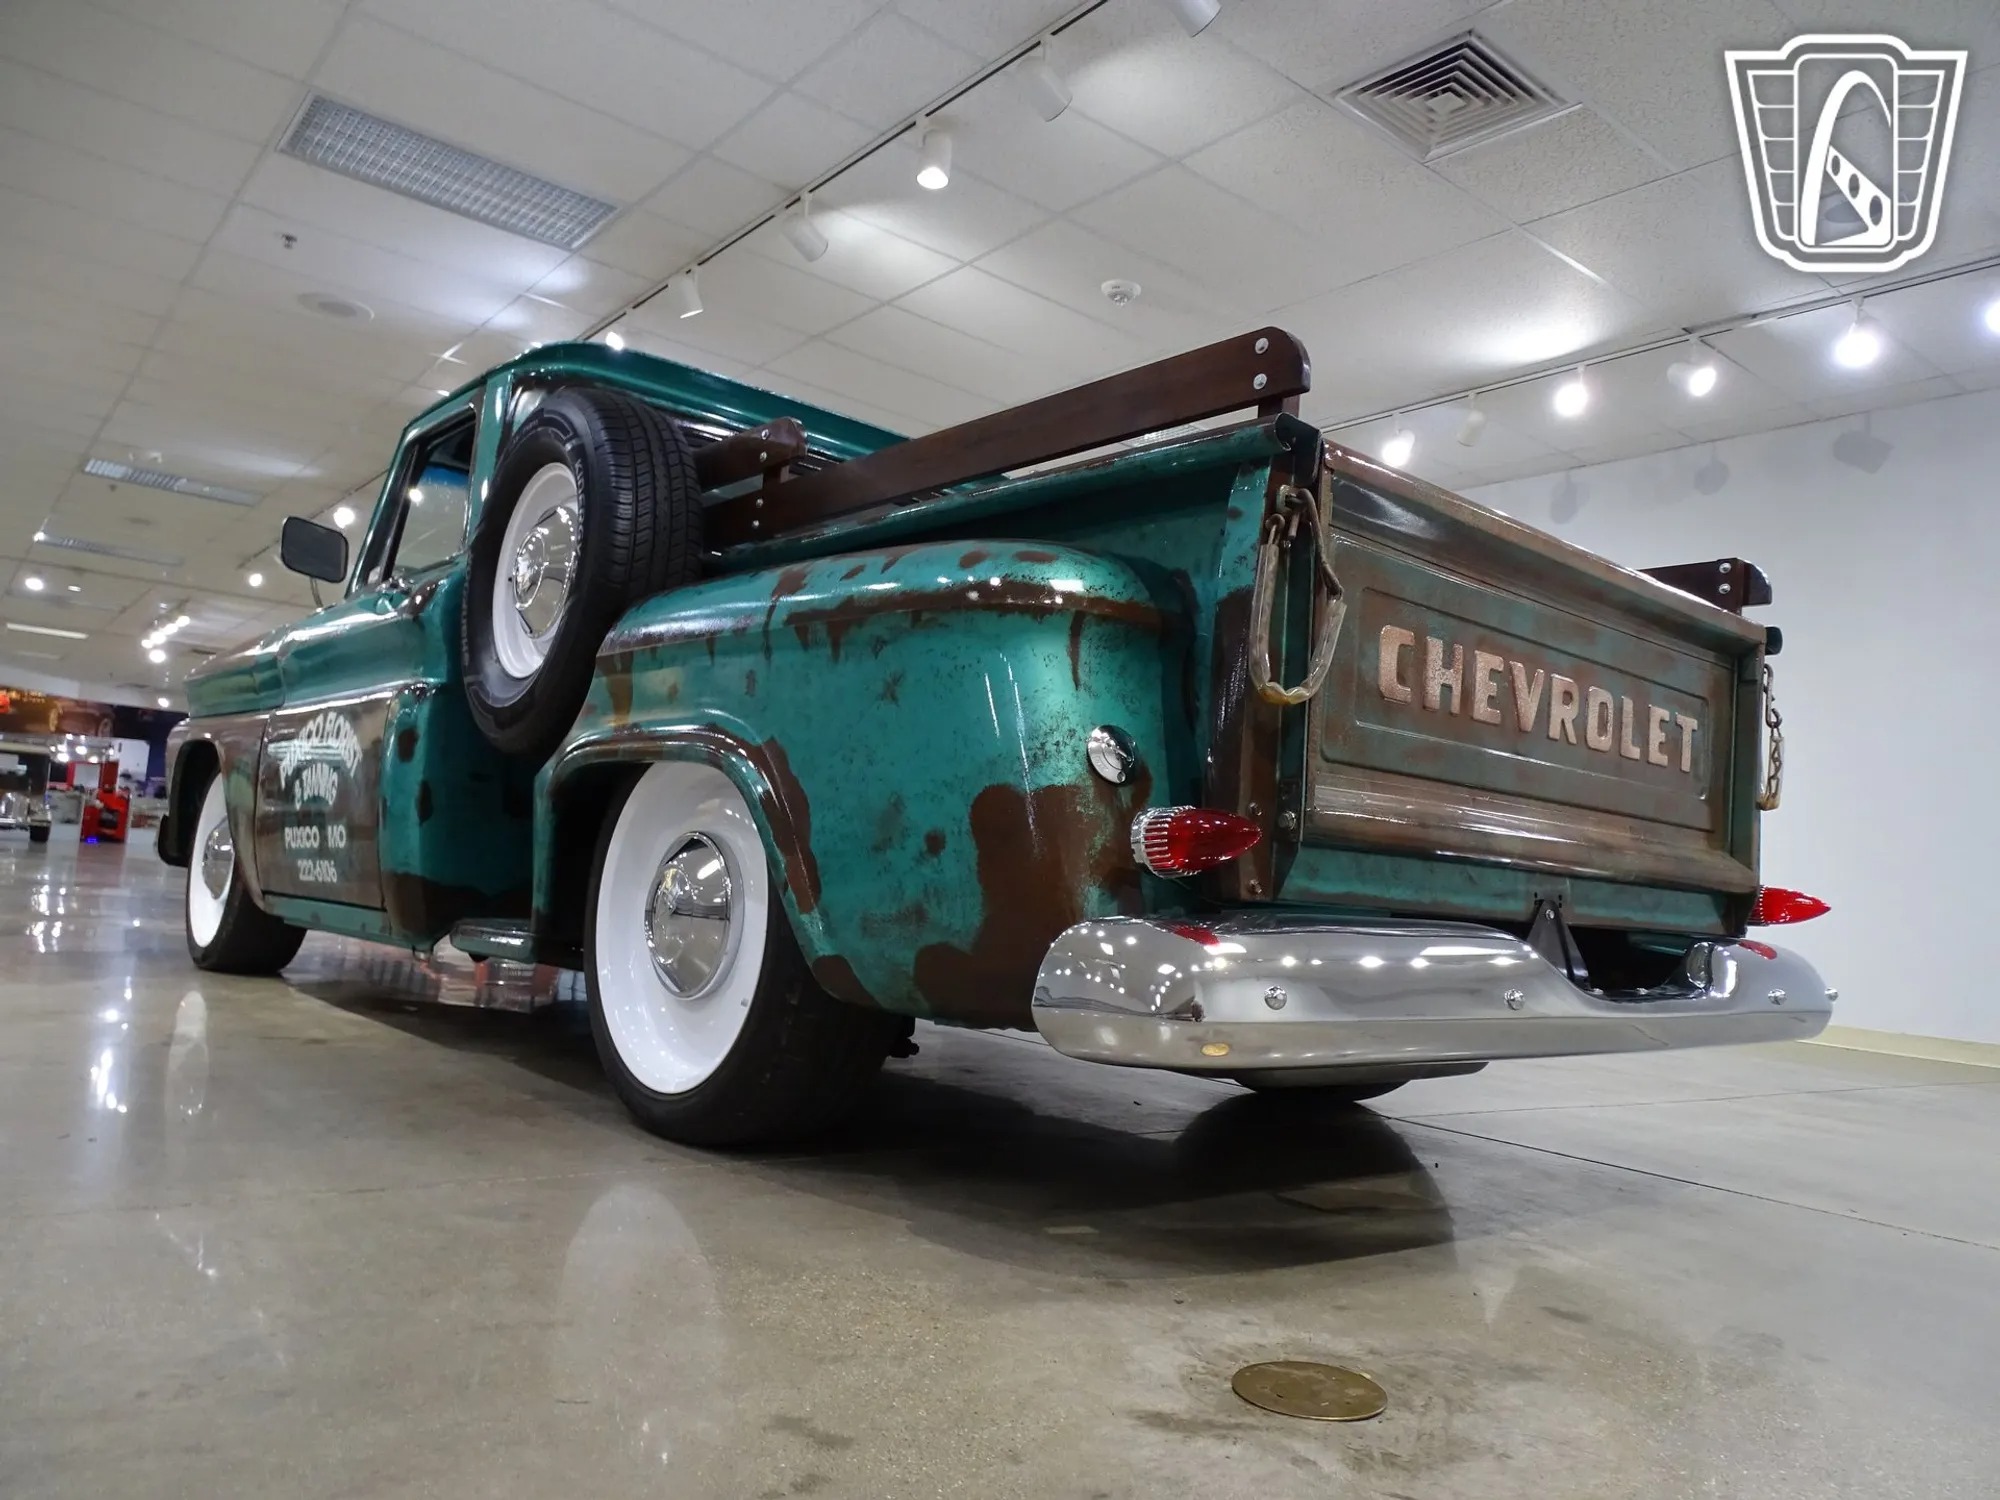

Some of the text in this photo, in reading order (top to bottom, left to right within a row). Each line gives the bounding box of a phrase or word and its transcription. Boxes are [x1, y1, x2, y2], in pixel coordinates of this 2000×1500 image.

[1378, 624, 1699, 773] CHEVROLET
[285, 824, 346, 849] PUXICO MO
